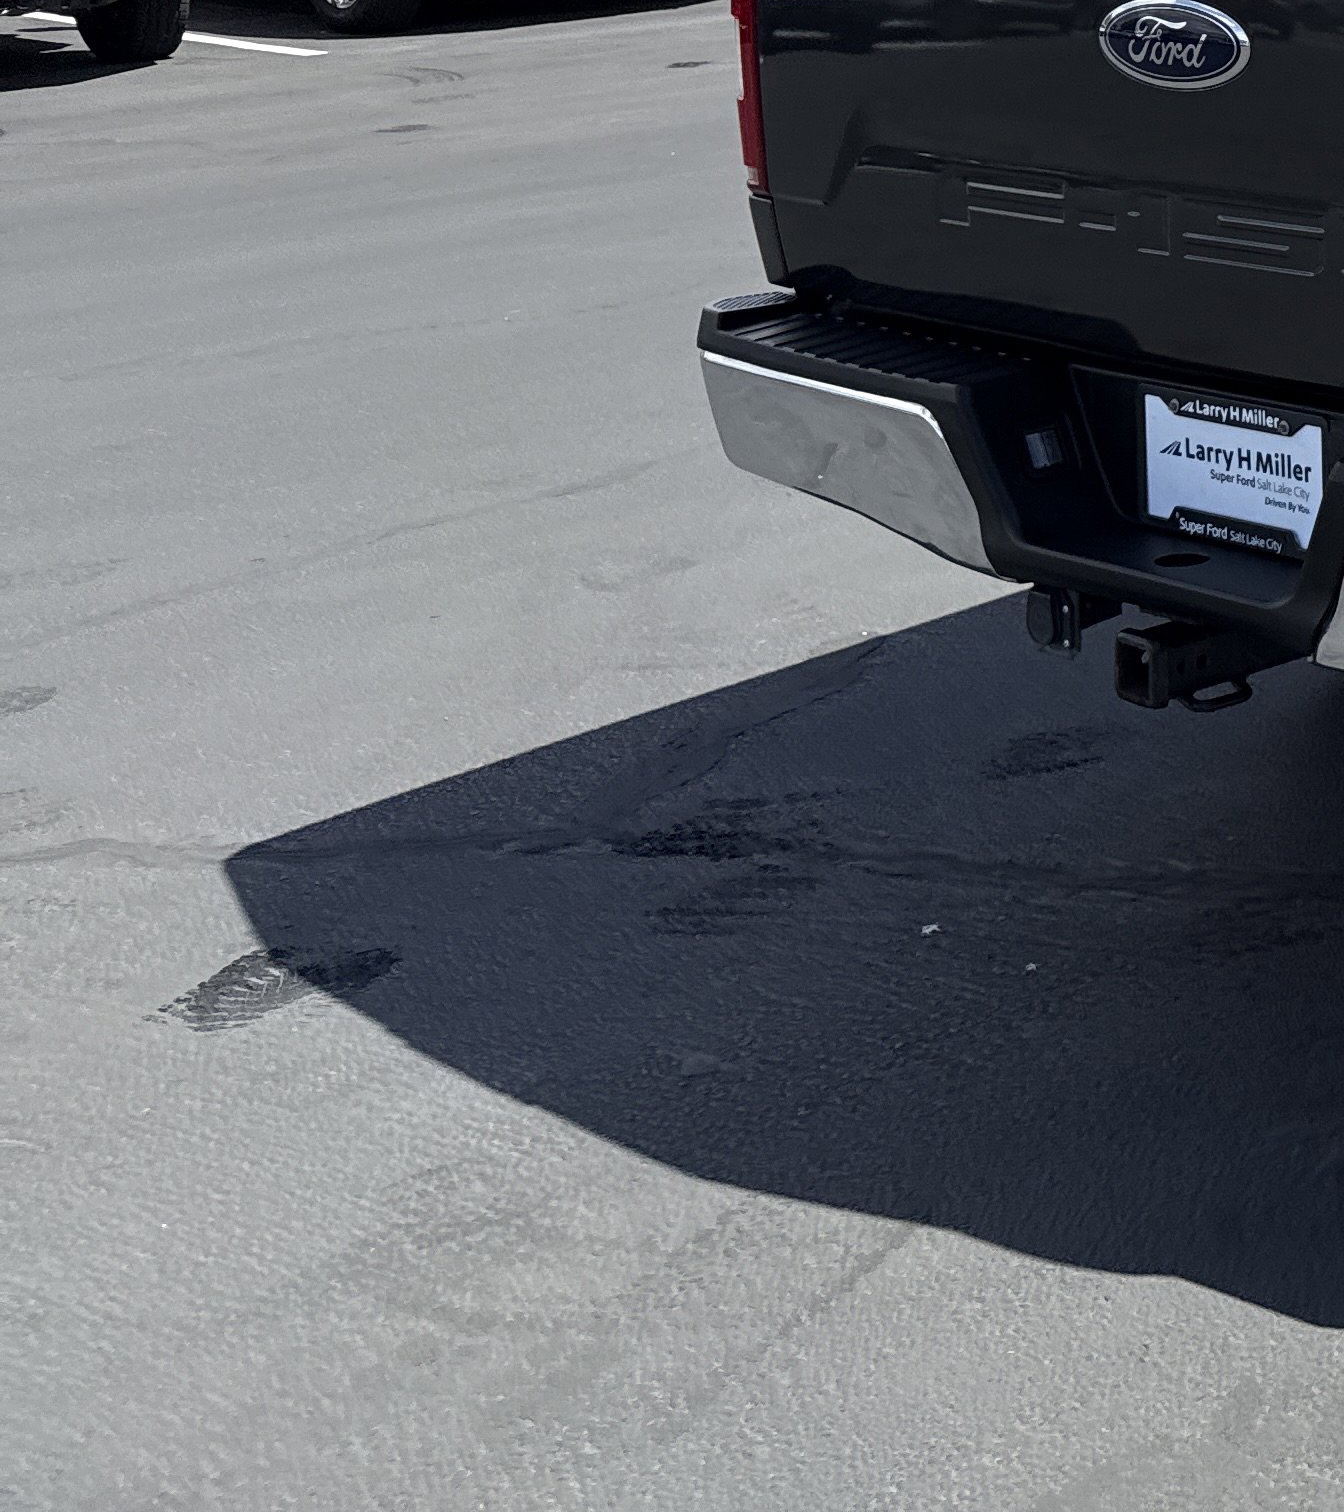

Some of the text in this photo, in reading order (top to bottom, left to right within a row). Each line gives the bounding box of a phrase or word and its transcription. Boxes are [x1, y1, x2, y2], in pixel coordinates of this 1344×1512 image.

[1128, 15, 1207, 68] Ford
[1195, 400, 1280, 429] Larry H Miller
[1185, 437, 1312, 483] Larry H Miller
[1210, 468, 1311, 503] Super Ford Salt Lake City
[1264, 496, 1287, 509] Driven
[1179, 516, 1283, 554] Super Ford Salt Lake City
